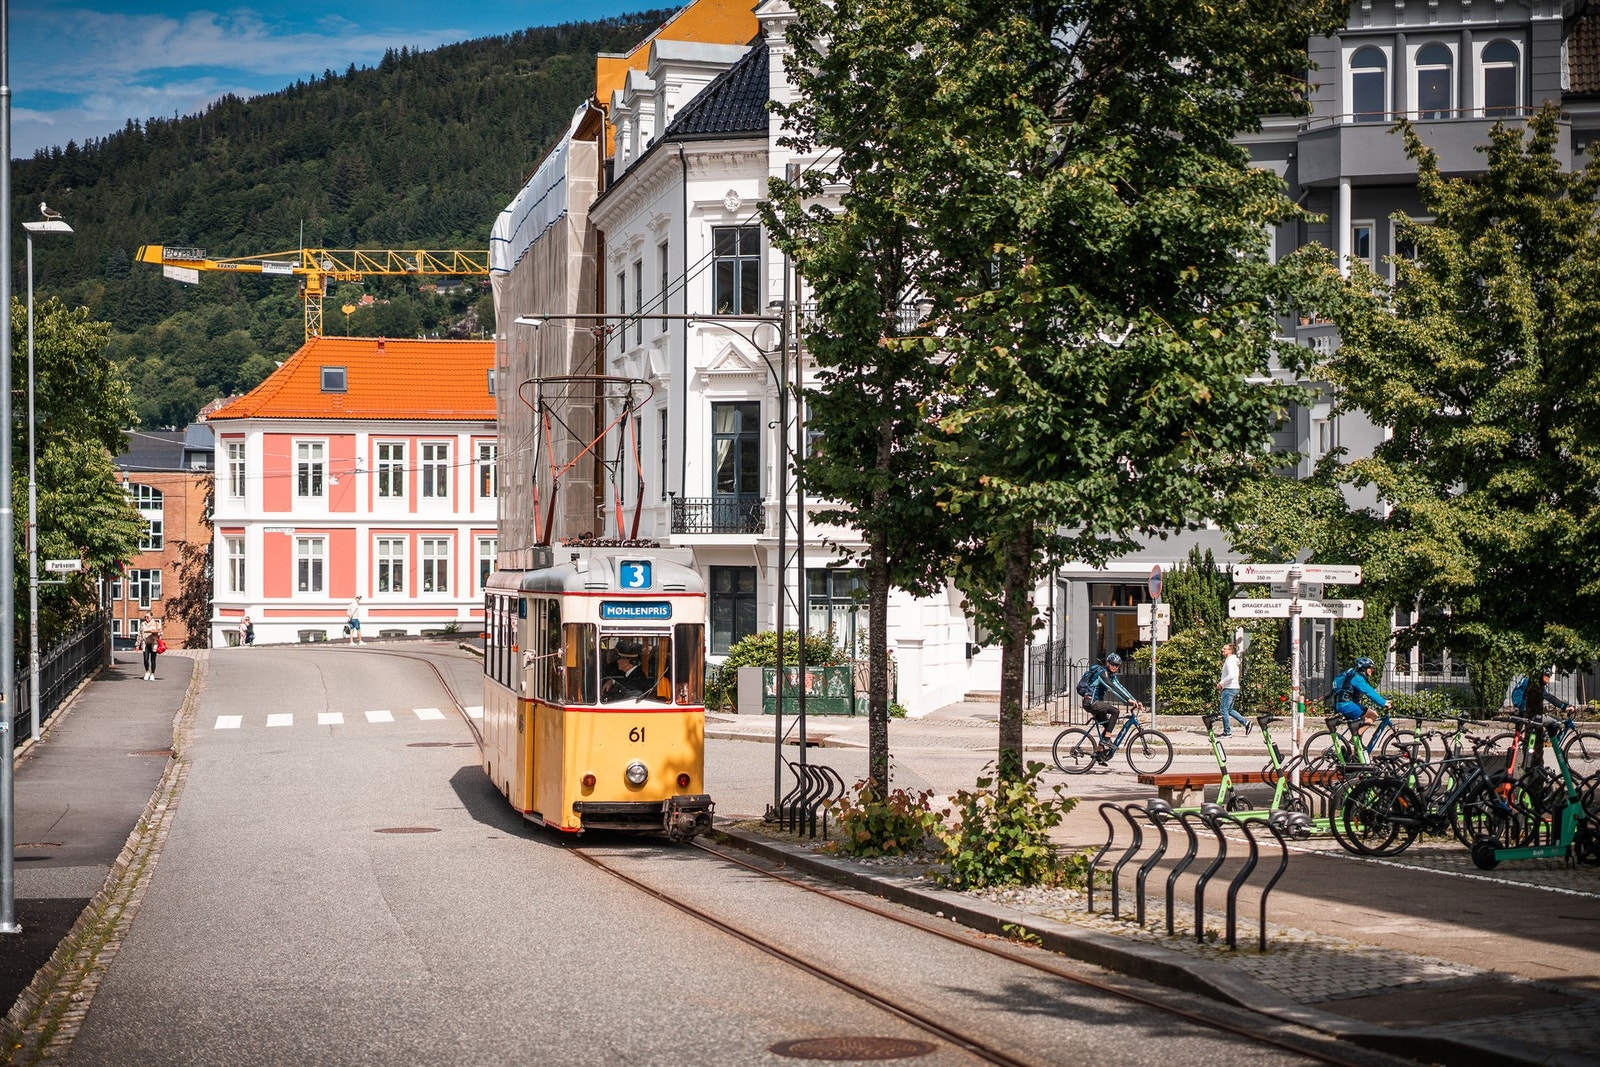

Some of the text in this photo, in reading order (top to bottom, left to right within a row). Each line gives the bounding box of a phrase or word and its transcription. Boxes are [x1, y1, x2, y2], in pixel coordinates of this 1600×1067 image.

[629, 563, 645, 588] 3
[607, 606, 667, 615] MØHLENPRIS
[629, 726, 645, 743] 61
